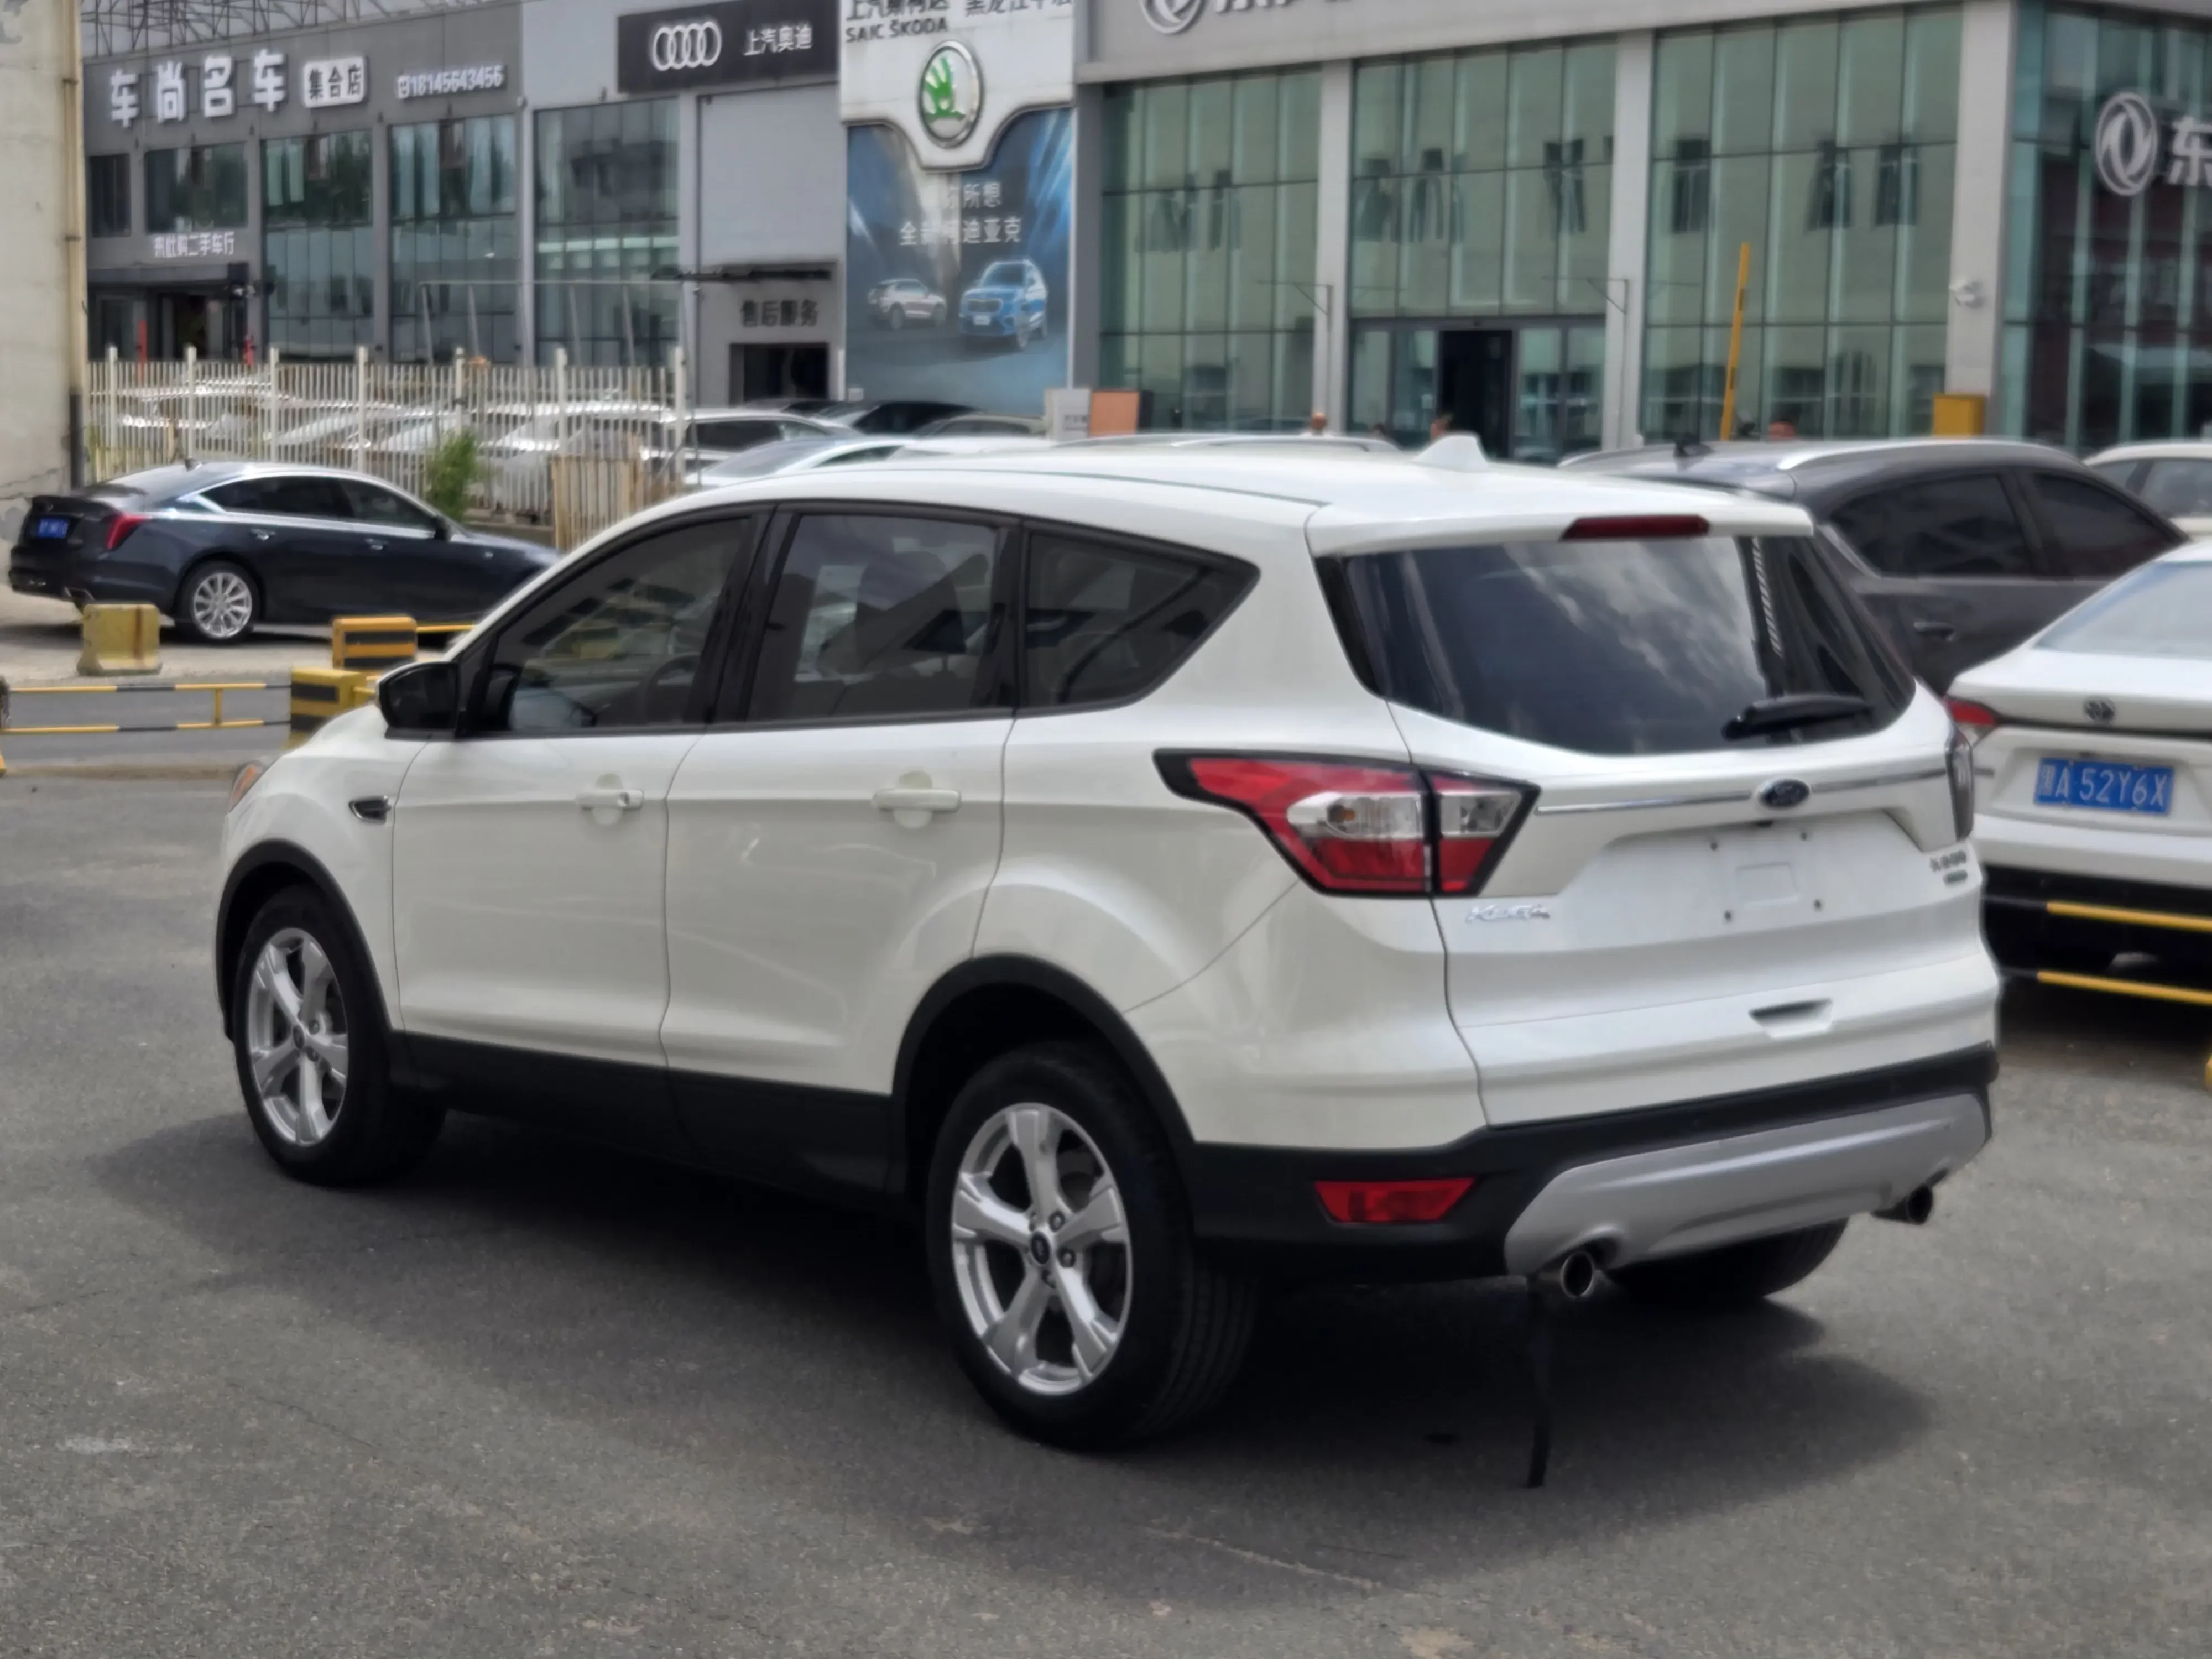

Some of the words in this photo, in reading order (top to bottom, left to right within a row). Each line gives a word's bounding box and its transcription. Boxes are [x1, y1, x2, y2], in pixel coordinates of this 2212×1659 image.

[743, 24, 813, 56] 上汽奥迪
[846, 24, 885, 43] SAIC
[111, 49, 285, 128] 车尚名车
[309, 64, 361, 100] 集合店
